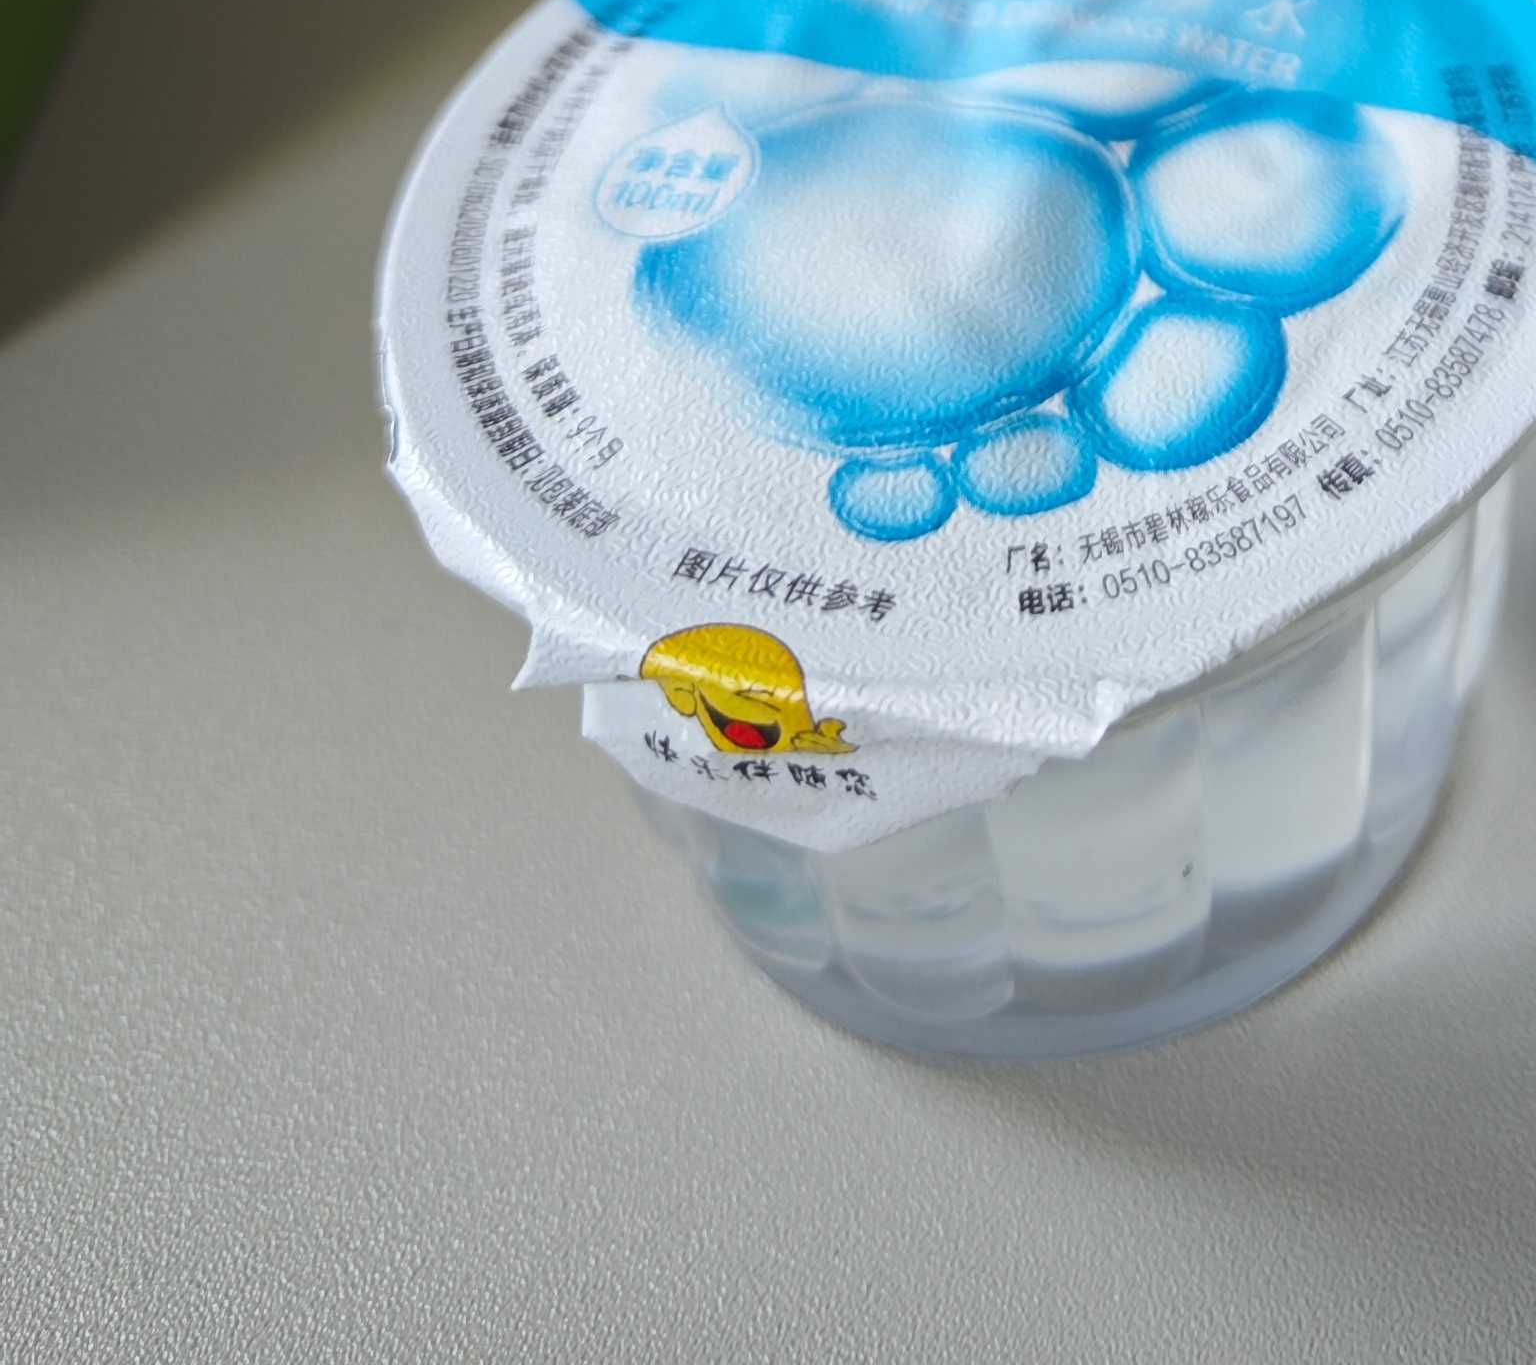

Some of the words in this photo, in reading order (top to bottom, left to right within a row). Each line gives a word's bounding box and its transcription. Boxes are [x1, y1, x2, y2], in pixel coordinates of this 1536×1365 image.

[671, 547, 898, 622] 图片仅供参考
